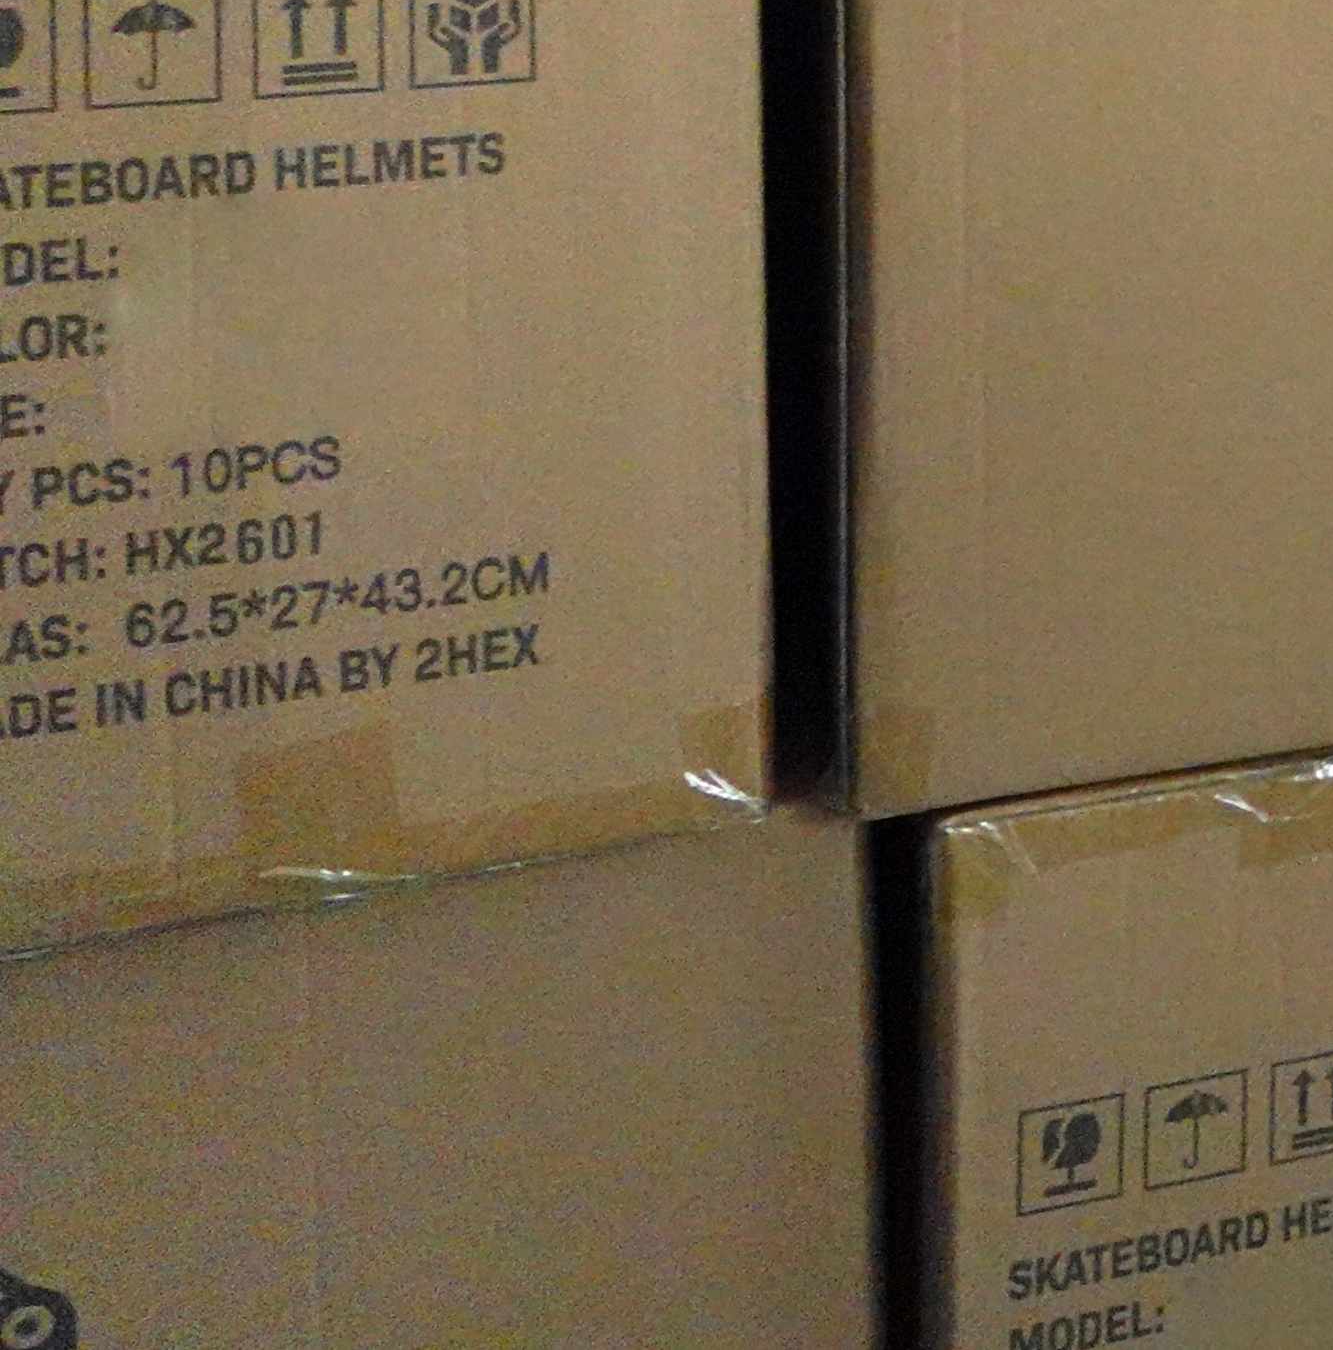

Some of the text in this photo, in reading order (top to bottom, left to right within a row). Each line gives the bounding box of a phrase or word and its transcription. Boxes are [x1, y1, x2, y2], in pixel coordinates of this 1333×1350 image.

[273, 132, 506, 192] HELMETS
[0, 238, 119, 286] DEL:
[31, 458, 151, 509] PCS:
[171, 436, 342, 496] 10PCS
[0, 614, 89, 666] AS:
[95, 678, 147, 727] IN
[164, 656, 322, 716] CHINA
[340, 647, 398, 692] BY
[414, 624, 541, 683] 2HEX
[1008, 1210, 1270, 1300] SKATEBOARD
[1009, 1300, 1165, 1350] MODEL:
